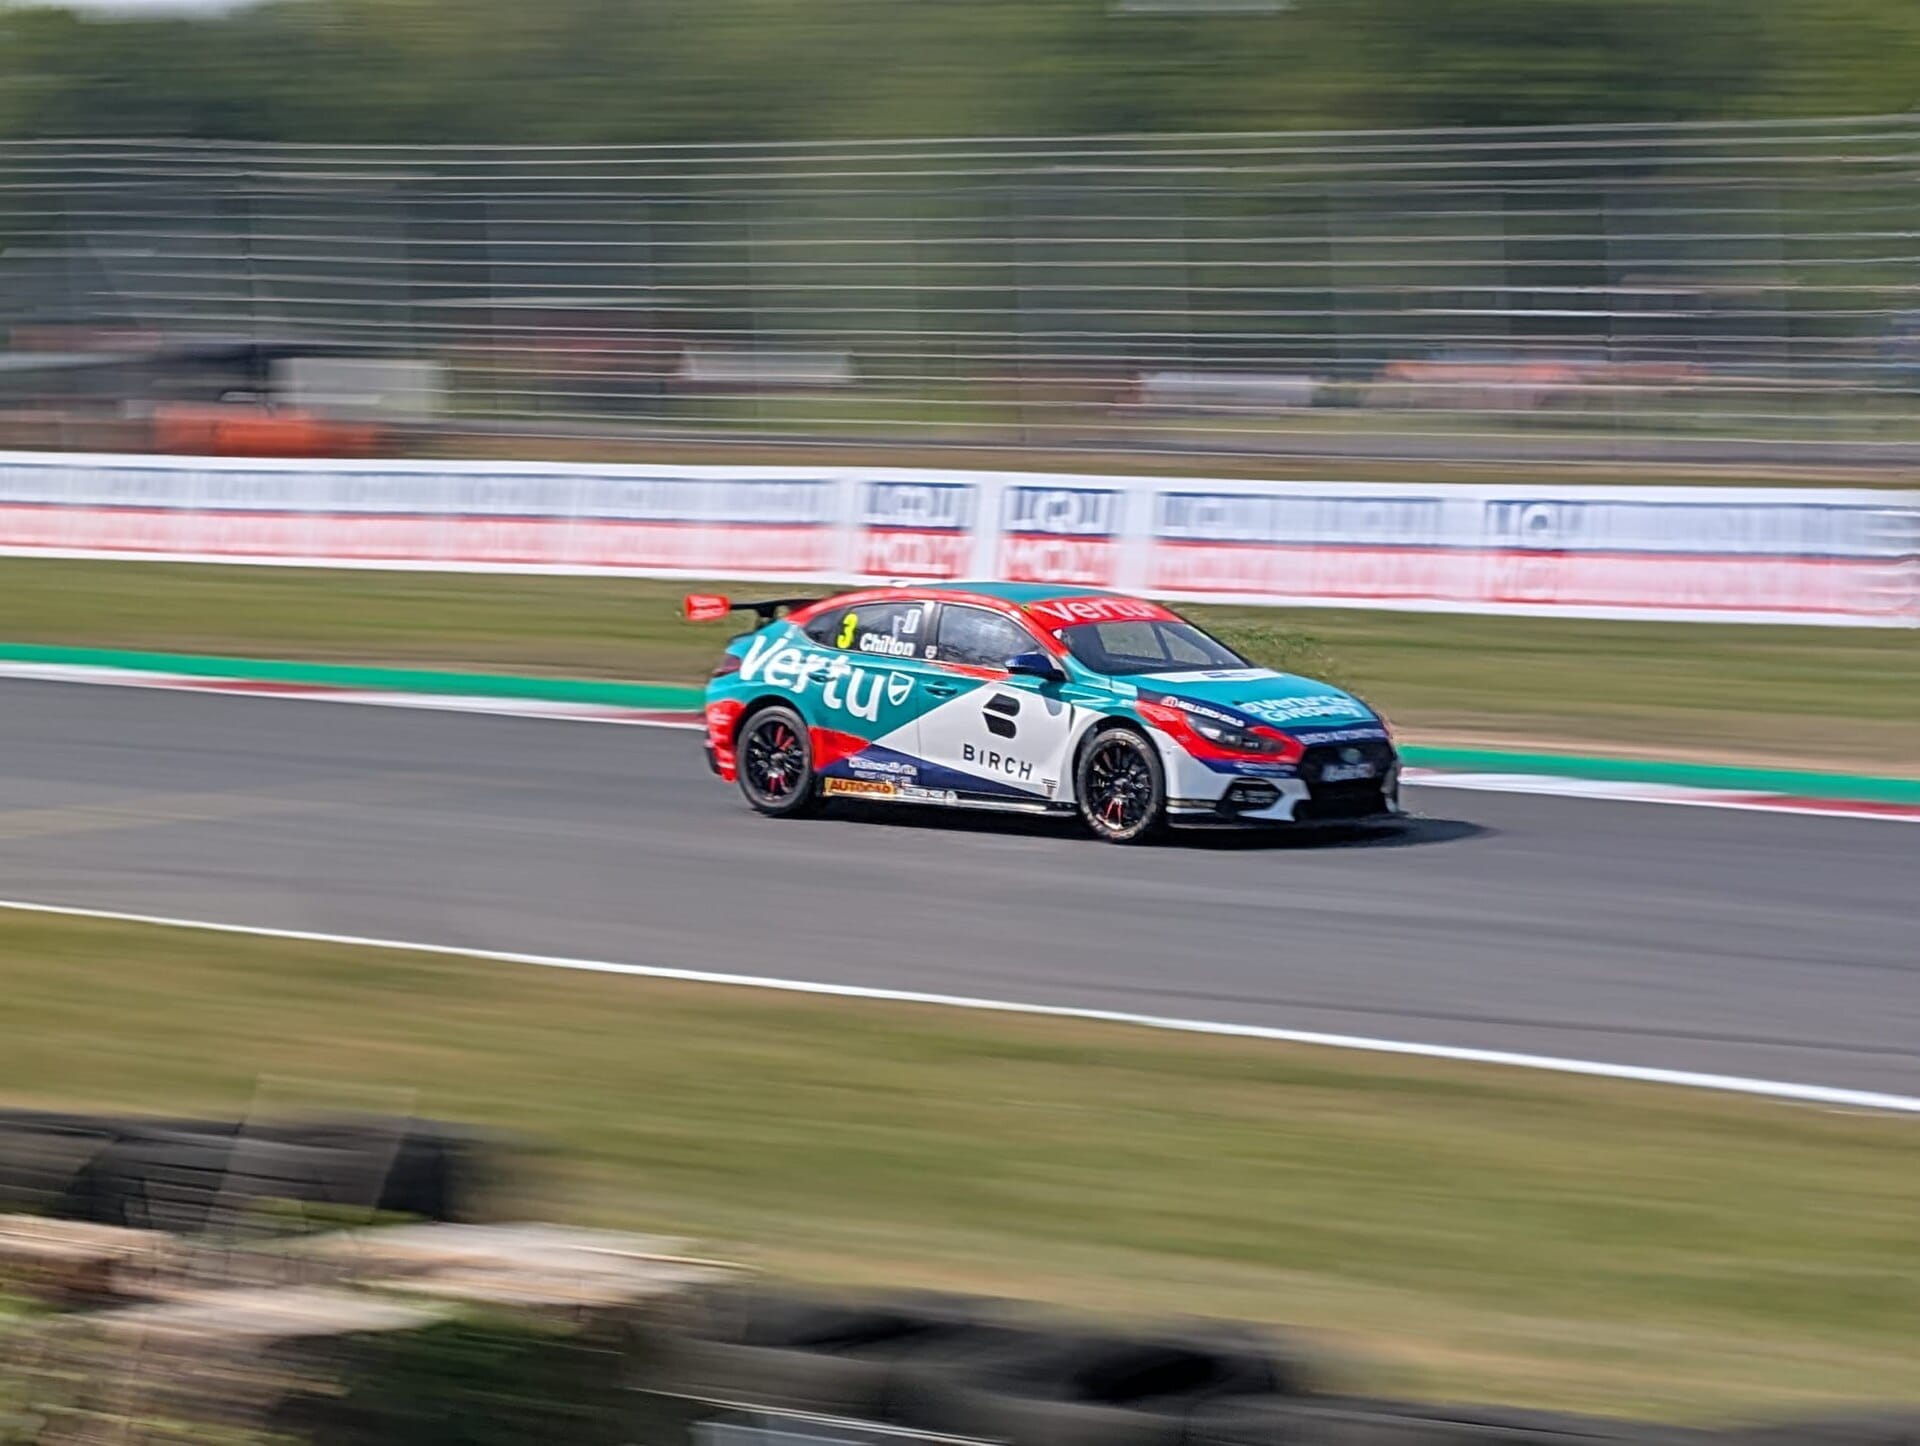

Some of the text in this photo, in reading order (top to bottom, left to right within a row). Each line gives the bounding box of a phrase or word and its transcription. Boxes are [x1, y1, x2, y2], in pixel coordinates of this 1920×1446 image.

[837, 613, 859, 649] 3
[860, 632, 916, 657] Chilton
[963, 743, 1034, 781] BIRCH
